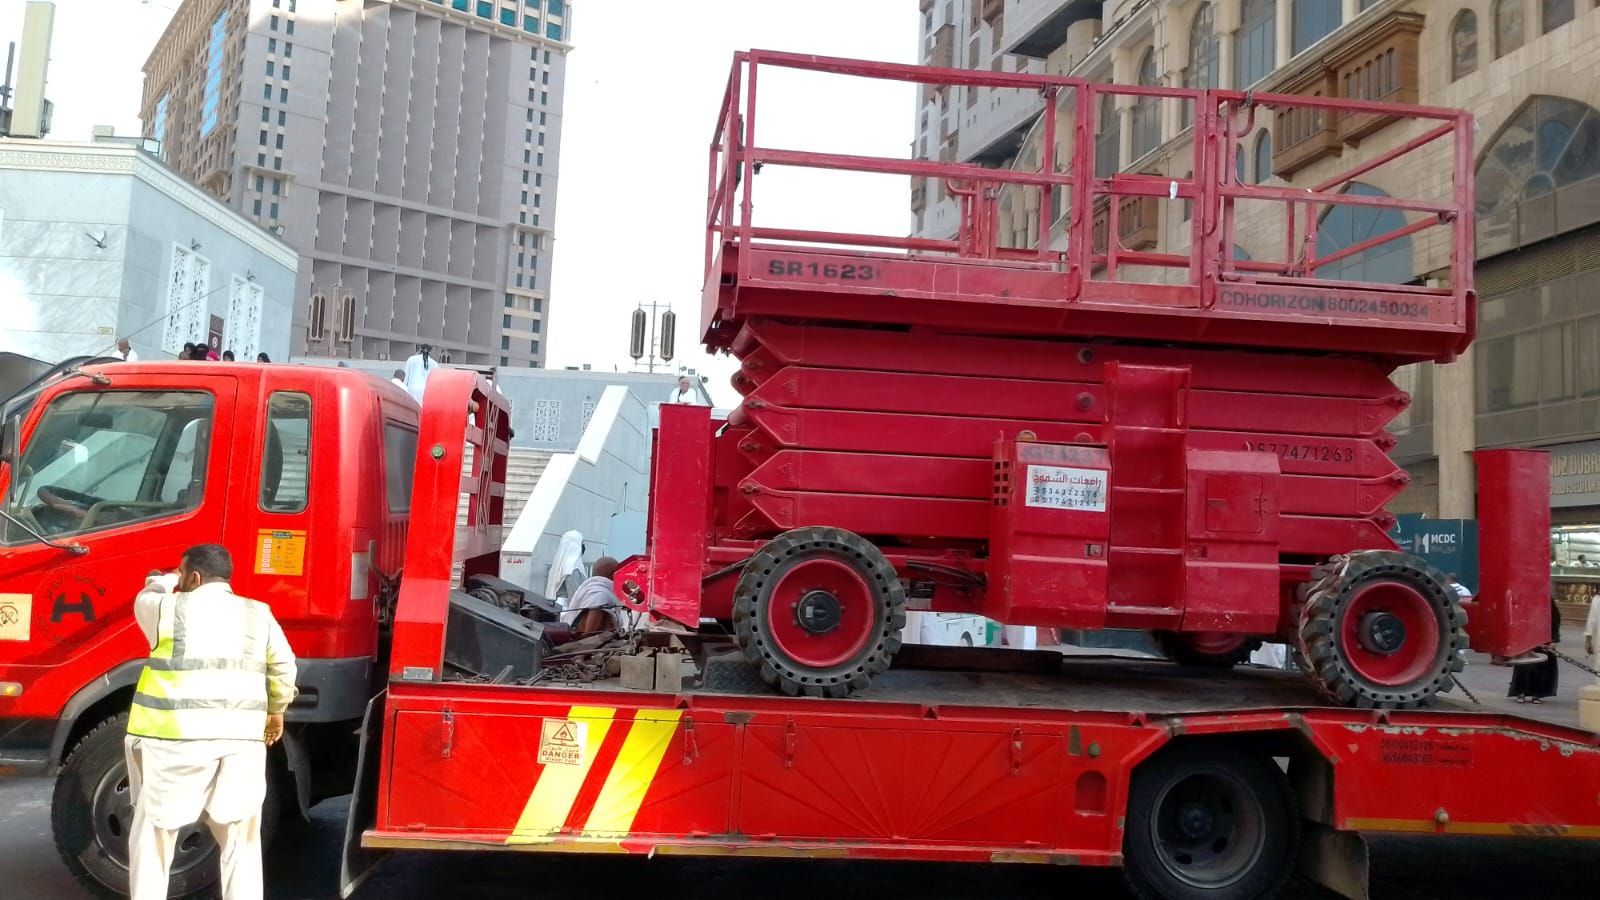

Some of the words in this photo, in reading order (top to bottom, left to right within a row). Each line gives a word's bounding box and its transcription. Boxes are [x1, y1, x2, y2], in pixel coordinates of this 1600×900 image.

[768, 259, 874, 280] SR1623
[1431, 533, 1456, 544] MCDC
[542, 750, 580, 760] DANGER
